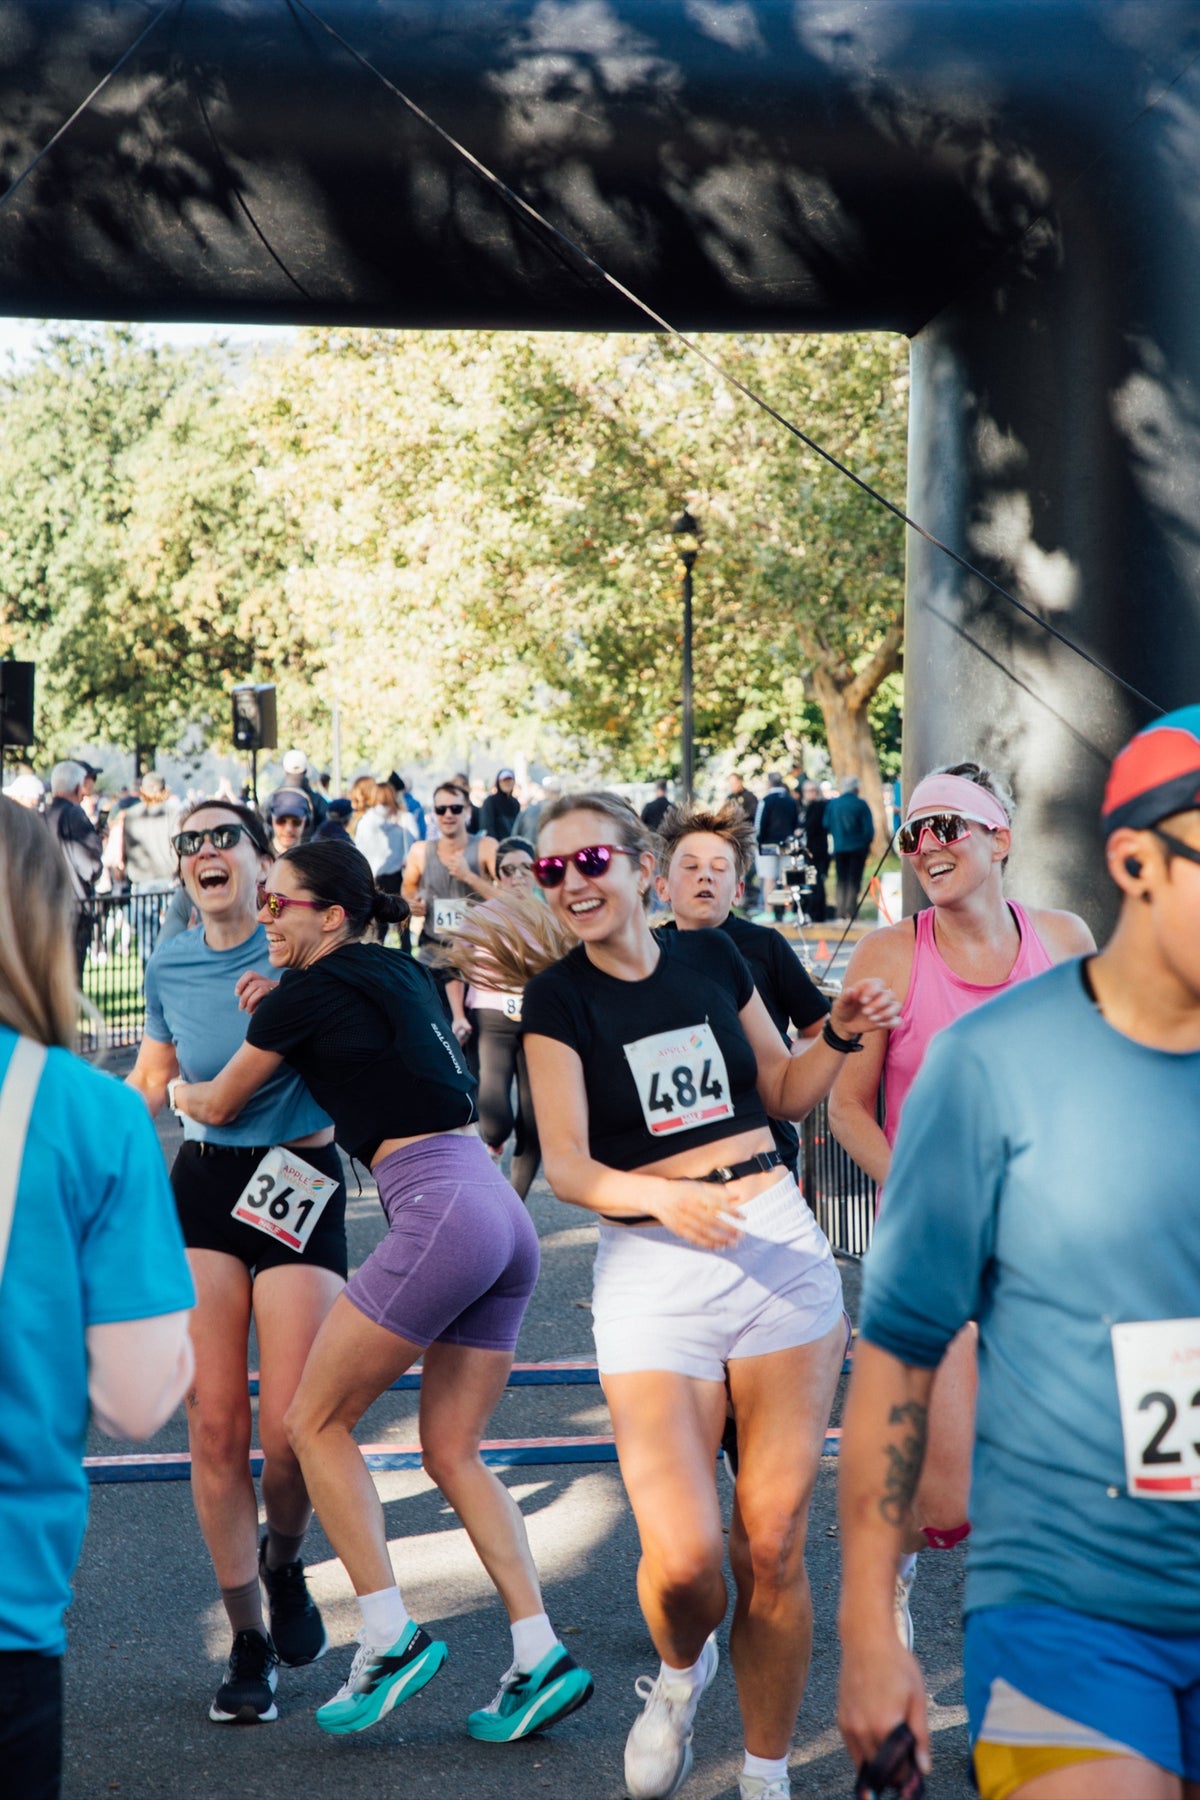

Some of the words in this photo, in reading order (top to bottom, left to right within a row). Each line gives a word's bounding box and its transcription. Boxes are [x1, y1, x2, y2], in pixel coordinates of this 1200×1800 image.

[507, 999, 522, 1014] 8
[431, 1023, 462, 1074] SALOMON
[649, 1058, 723, 1113] 484
[283, 1165, 311, 1185] APPLE
[247, 1174, 315, 1234] 361
[1137, 1389, 1200, 1465] 2
